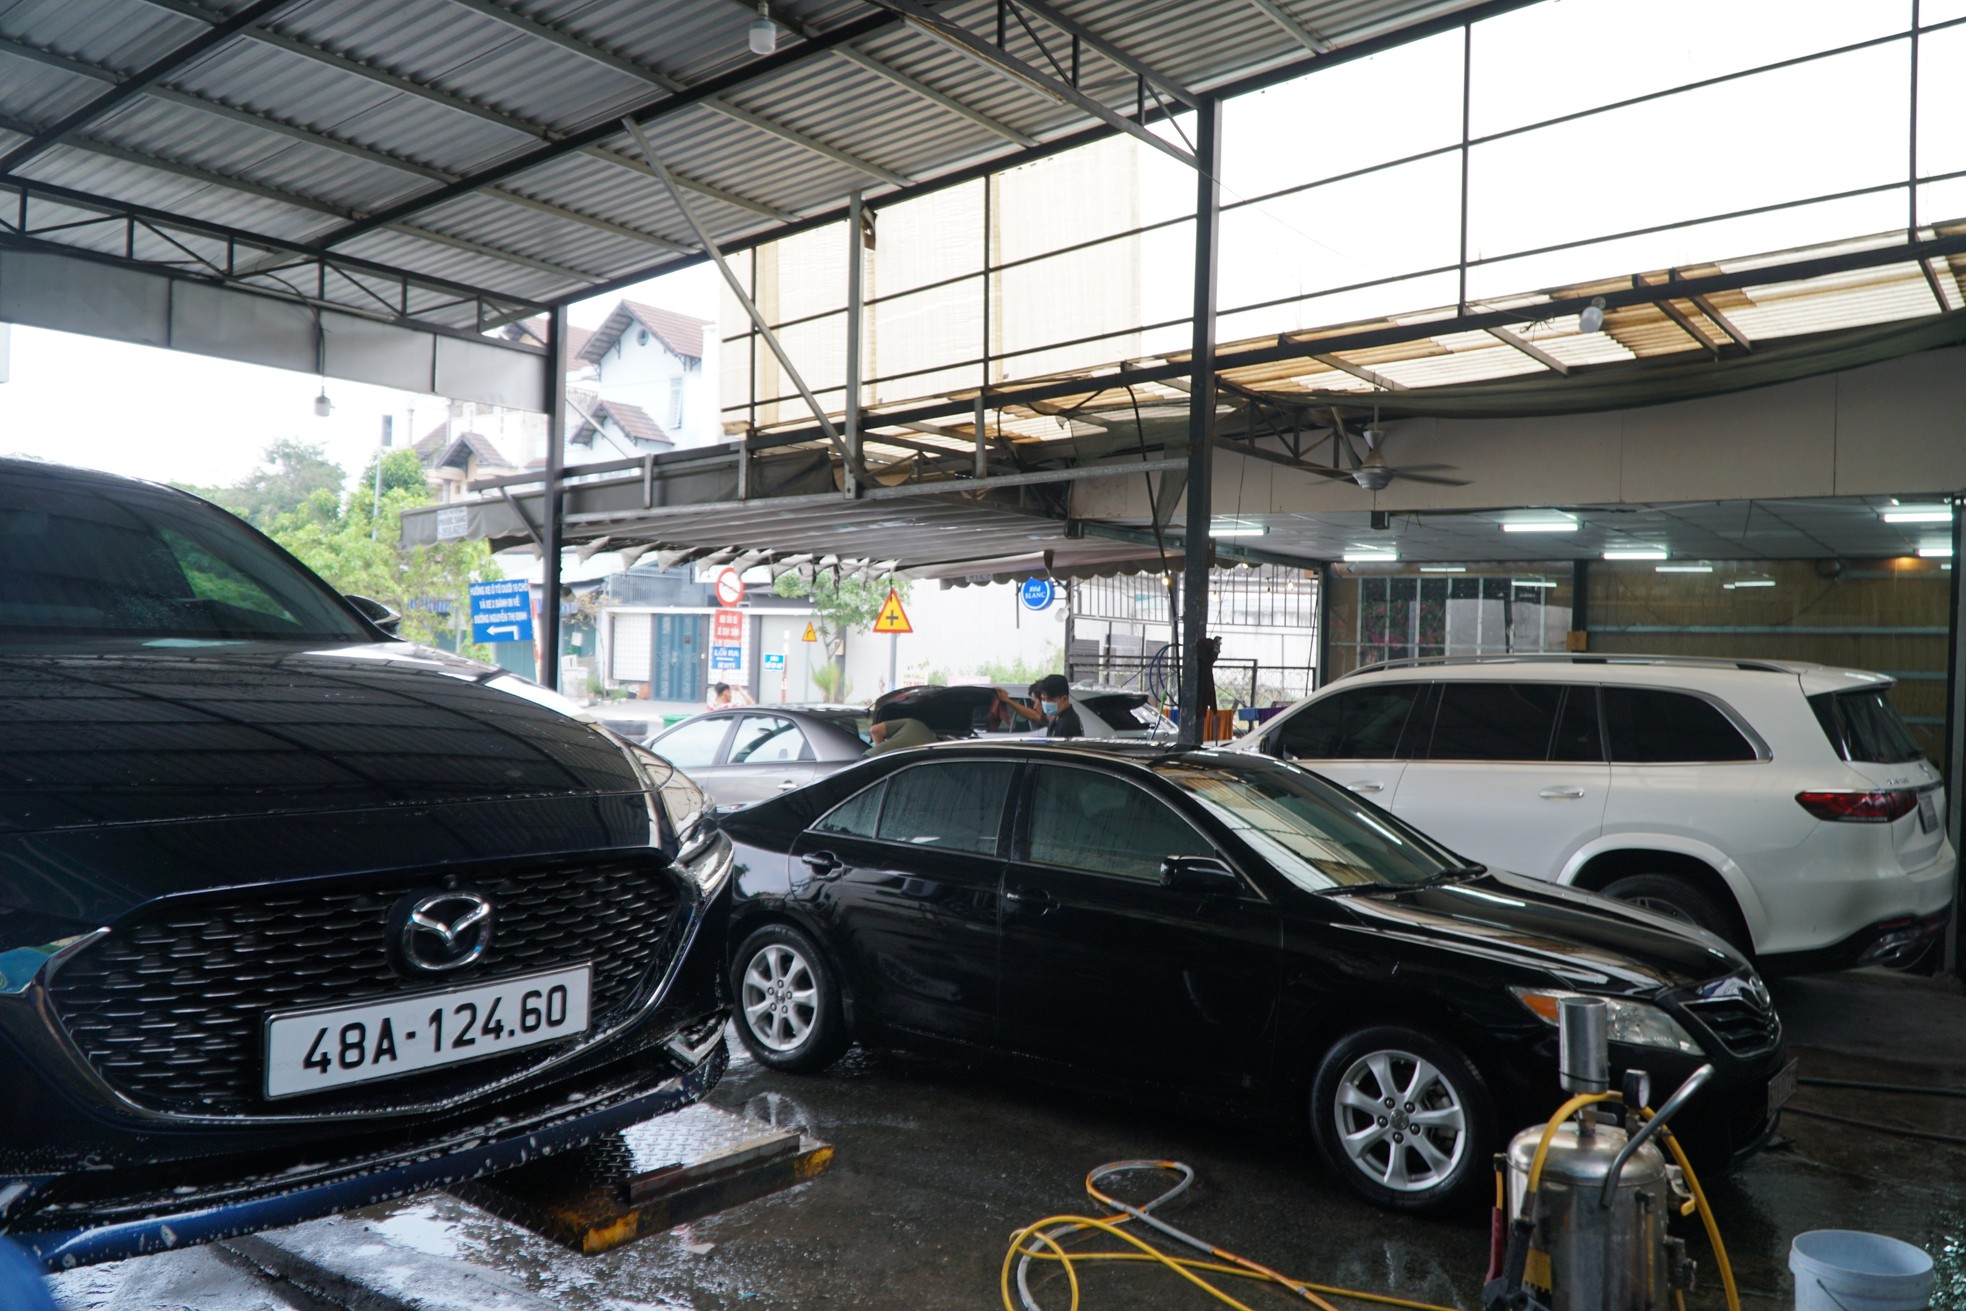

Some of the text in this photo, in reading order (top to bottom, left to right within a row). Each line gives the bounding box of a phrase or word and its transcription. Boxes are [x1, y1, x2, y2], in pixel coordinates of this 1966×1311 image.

[1024, 591, 1046, 599] BLANC
[728, 649, 739, 657] RA
[303, 984, 567, 1075] 48A-124.60
